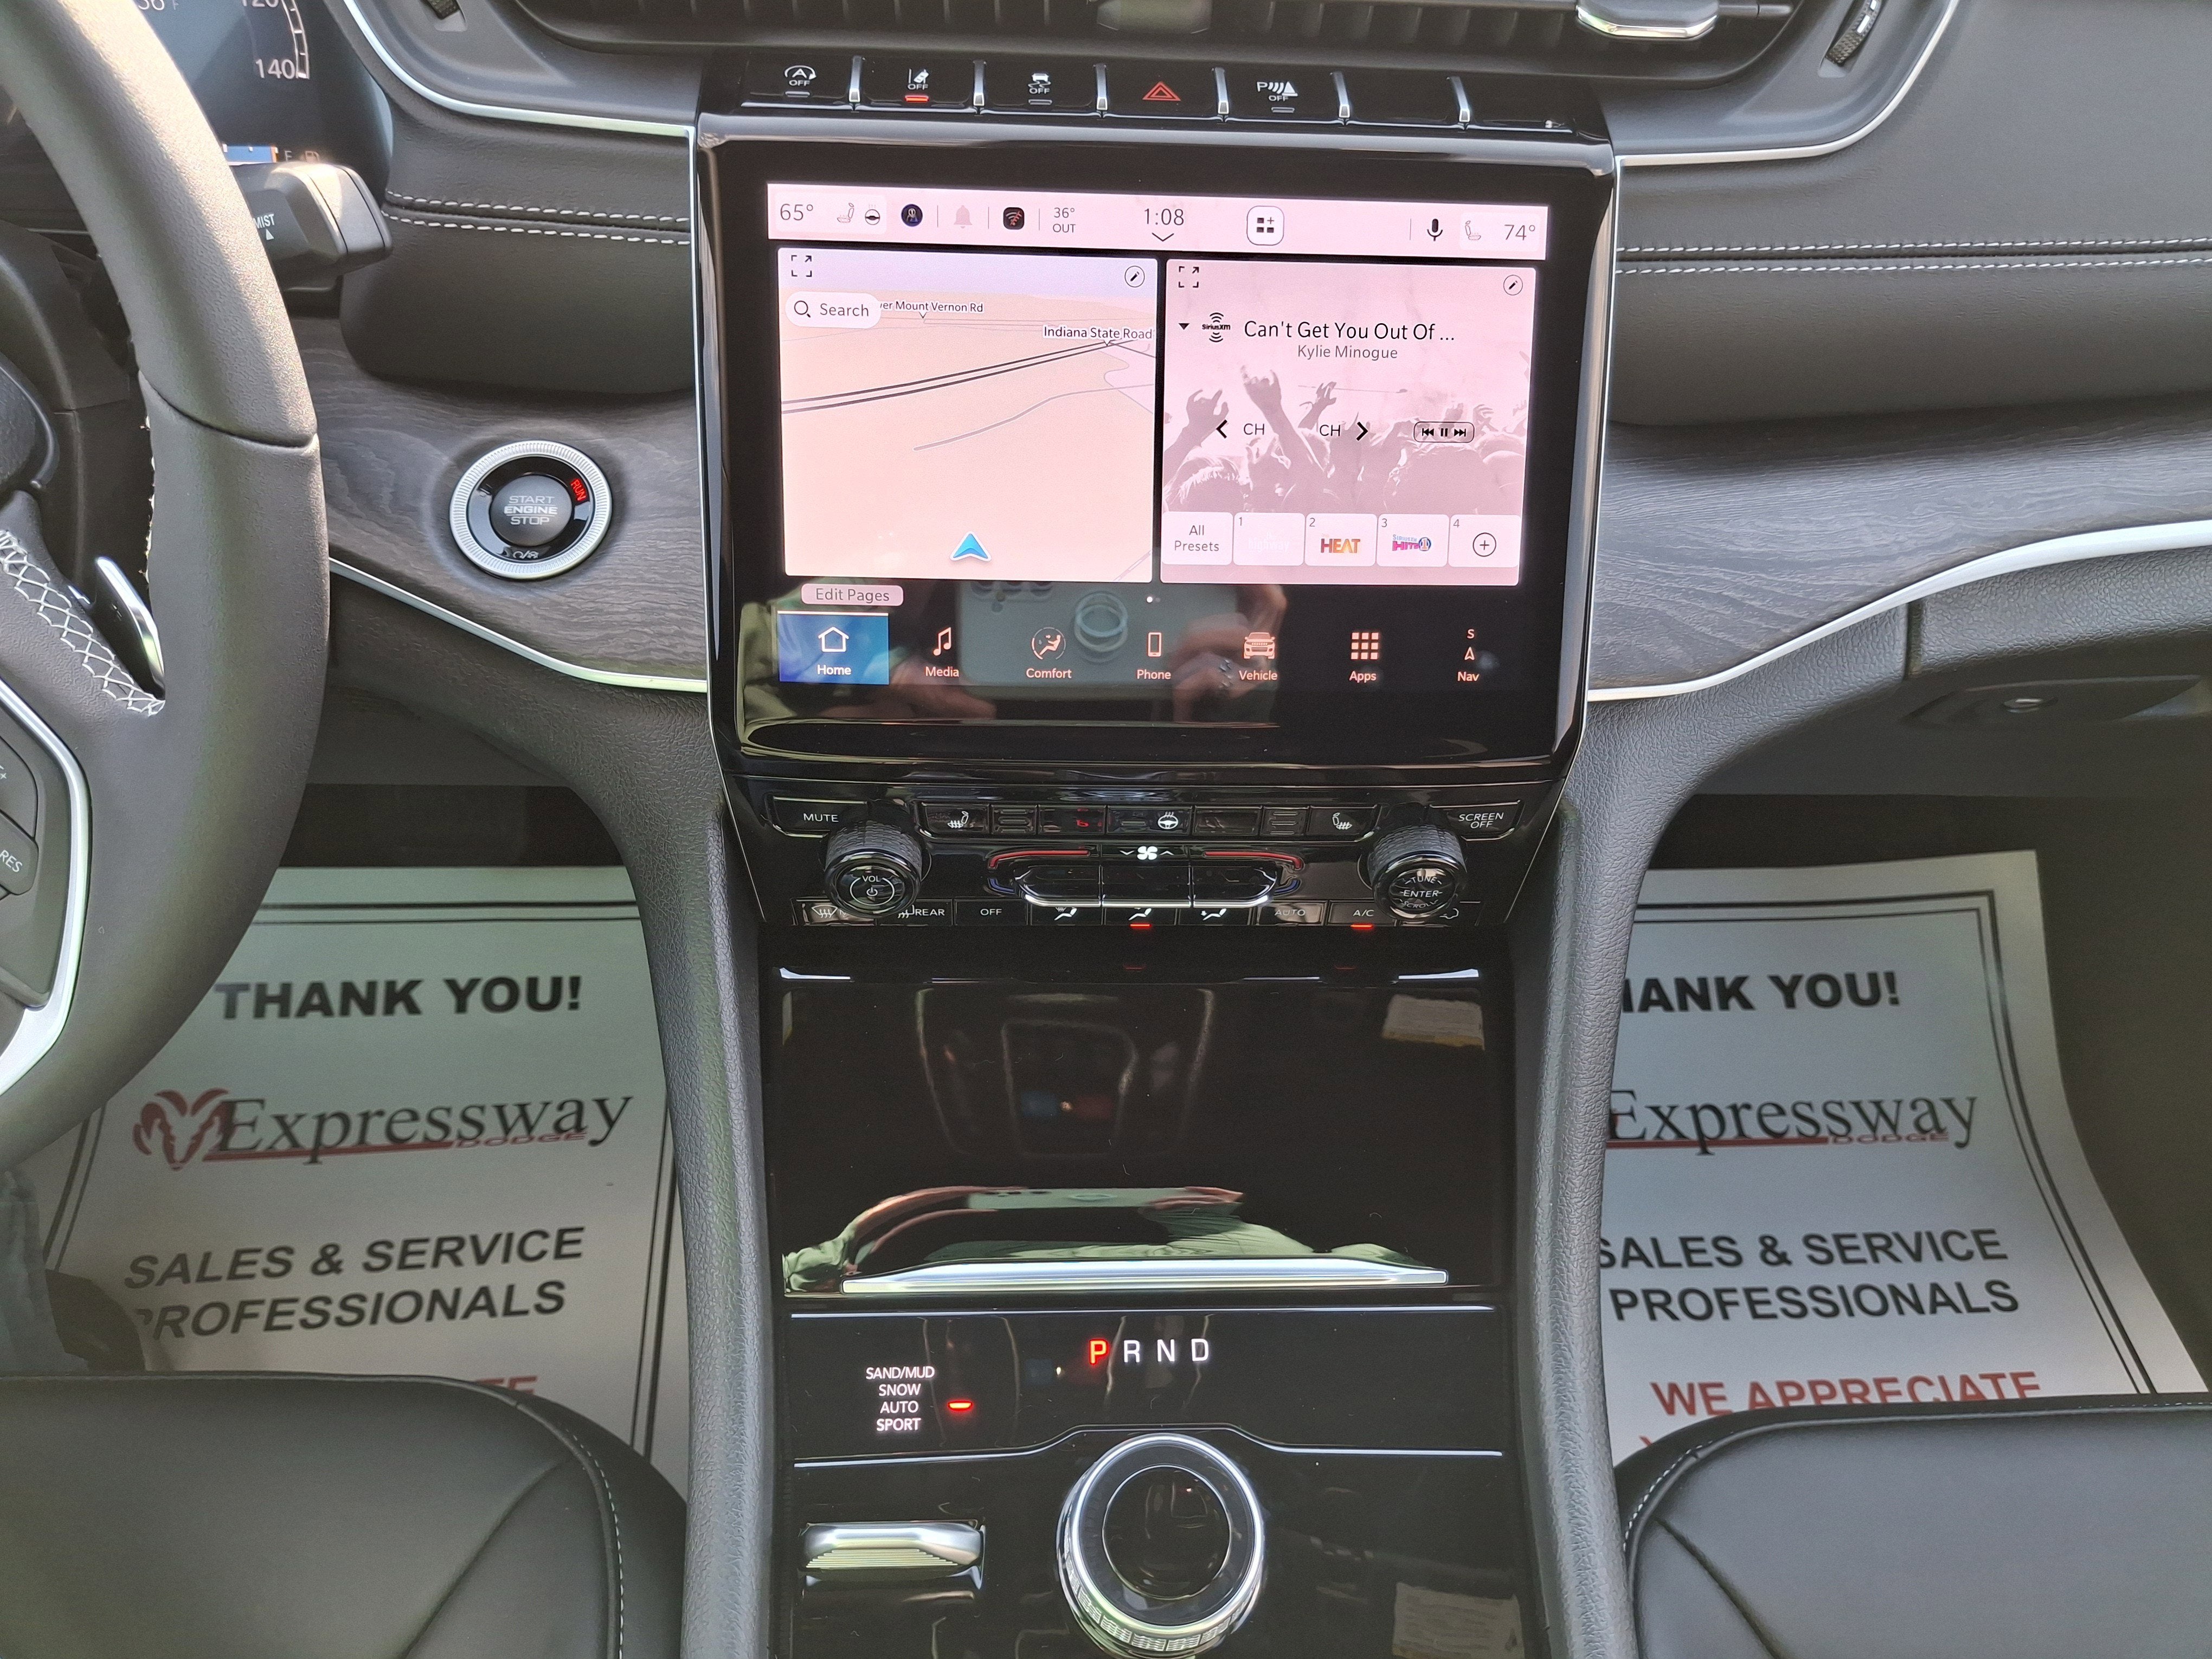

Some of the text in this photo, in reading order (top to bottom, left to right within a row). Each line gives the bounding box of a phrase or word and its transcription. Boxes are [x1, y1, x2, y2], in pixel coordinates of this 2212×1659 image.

[255, 59, 295, 79] 140
[780, 203, 814, 221] 65°
[1053, 207, 1075, 218] 36°
[1143, 208, 1185, 226] 1:08
[253, 214, 275, 229] MIST
[1052, 223, 1076, 234] OUT
[1503, 224, 1536, 242] 74°
[819, 303, 870, 318] Search
[896, 301, 929, 311] Mount
[931, 302, 967, 312] Vernon
[970, 303, 983, 312] Rd
[1044, 326, 1153, 339] Indiana State Road
[1244, 320, 1293, 338] Can't
[1298, 321, 1329, 339] Get
[1335, 322, 1368, 340] You
[1374, 323, 1409, 340] Out
[1413, 324, 1436, 340] Of
[1298, 344, 1398, 362] Kylie Minogue
[1243, 423, 1265, 435] CH
[1319, 425, 1341, 437] CH
[570, 478, 588, 501] RUN
[508, 496, 555, 504] START
[504, 506, 558, 515] ENGINE
[510, 516, 550, 525] STOP
[1238, 517, 1243, 526] 1
[1309, 517, 1316, 527] 2
[1381, 518, 1387, 528] 3
[1452, 519, 1460, 528] 4
[1188, 524, 1205, 536] All
[1174, 539, 1220, 552] Presets
[1321, 538, 1361, 554] HEAT
[815, 588, 890, 603] Edit Pages
[1467, 629, 1475, 639] S
[817, 664, 852, 676] Home
[925, 666, 960, 678] Media
[1026, 667, 1072, 679] Comfort
[1136, 669, 1172, 680] Phone
[1238, 670, 1278, 681] Vehicle
[1457, 671, 1480, 681] Nav
[1349, 671, 1377, 683] Apps
[803, 813, 839, 823] MUTE
[1458, 812, 1504, 822] SCREEN
[1470, 820, 1494, 829] OFF
[0, 850, 23, 873] RES
[1410, 876, 1438, 884] TUNE
[1401, 899, 1439, 909] SCROLL
[915, 908, 946, 917] REAR
[980, 908, 1002, 916] OFF
[1353, 909, 1375, 917] A/C
[1767, 971, 1900, 1009] YOU!
[214, 975, 582, 1020] THANK YOU!
[1607, 1090, 1978, 1156] Expressway
[219, 1095, 633, 1165] Expressway
[1758, 1234, 1792, 1266] &
[1802, 1227, 2008, 1265] SERVICE
[124, 1226, 586, 1289] SALES & SERVICE
[1608, 1279, 2019, 1321] PROFESSIONALS
[1089, 1338, 1210, 1365] P R N D
[865, 1366, 935, 1380] SAND/MUD
[878, 1383, 922, 1397] SNOW
[1650, 1370, 2043, 1416] WE APPRECIATE
[879, 1400, 919, 1414] AUTO
[876, 1418, 922, 1432] SPORT
